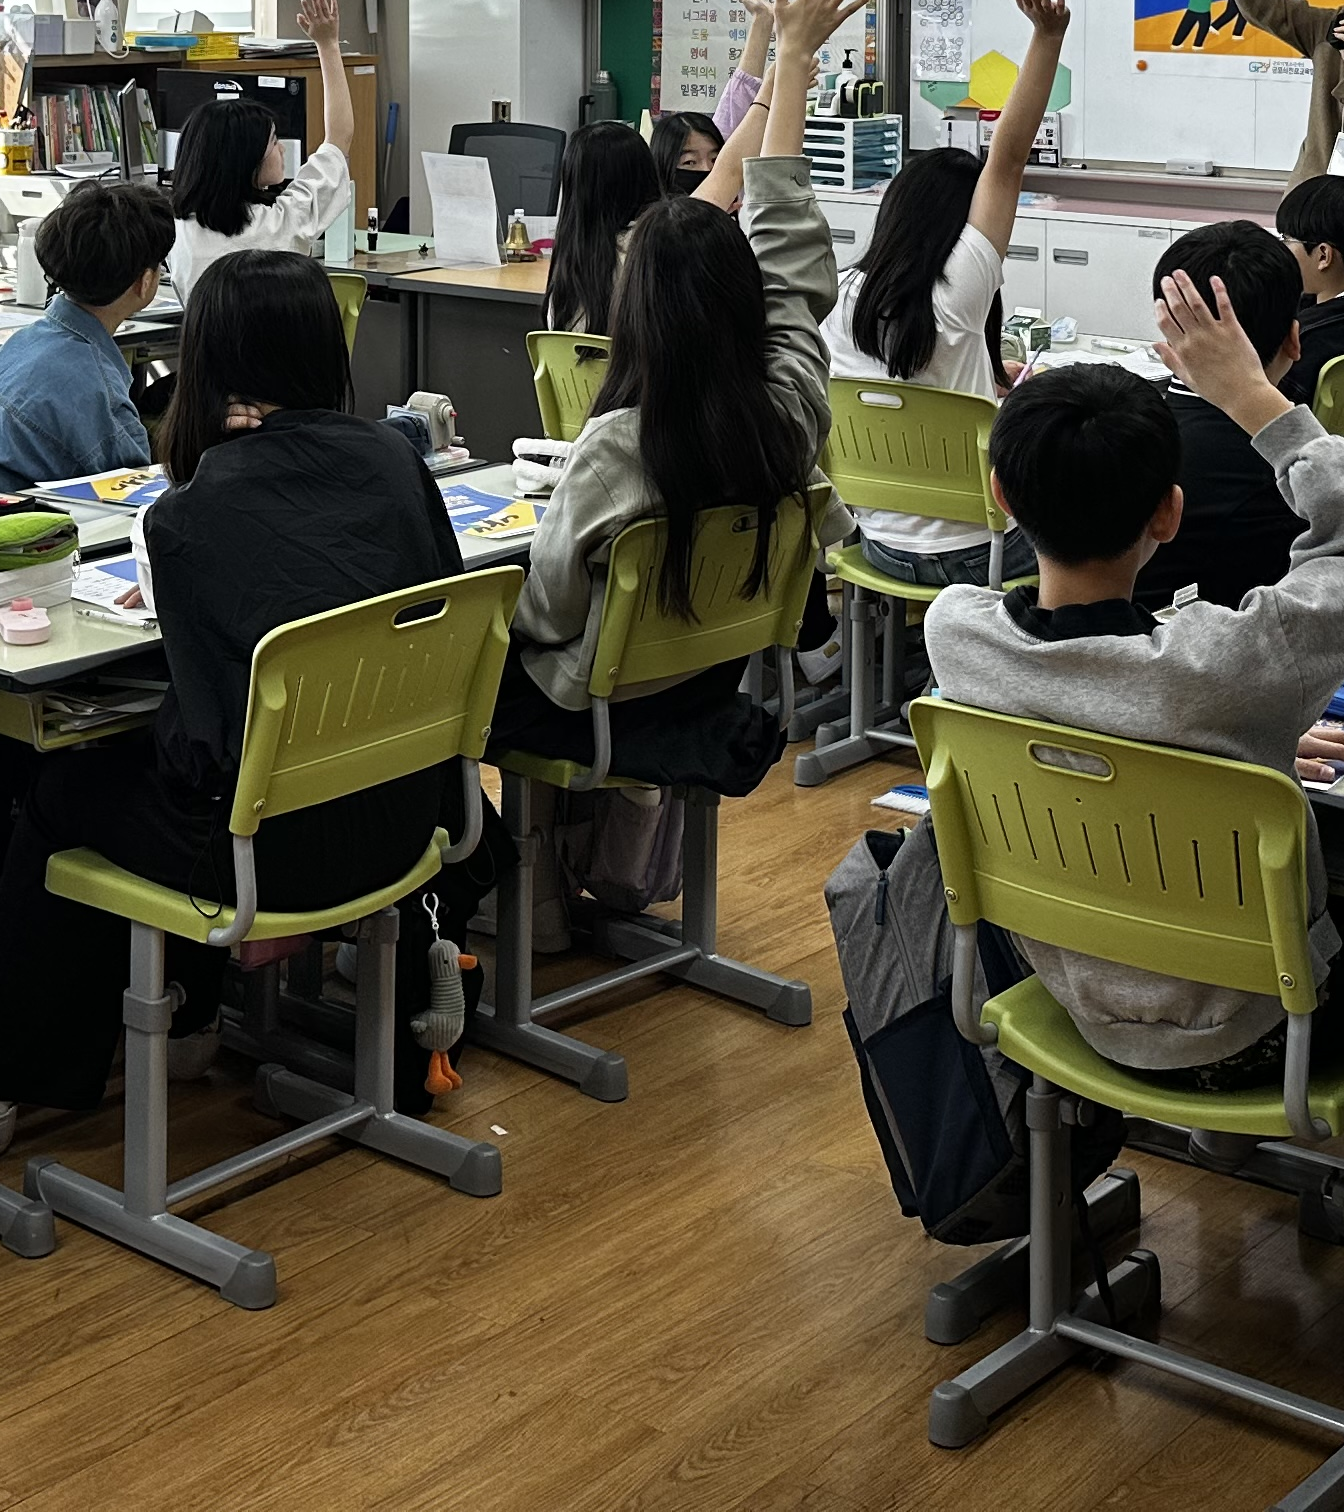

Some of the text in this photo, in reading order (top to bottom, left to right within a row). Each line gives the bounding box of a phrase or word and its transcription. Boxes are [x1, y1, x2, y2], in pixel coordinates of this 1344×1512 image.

[682, 9, 746, 23] 너그러움 열정
[680, 66, 717, 79] 목적의식
[680, 84, 717, 98] 믿음직함
